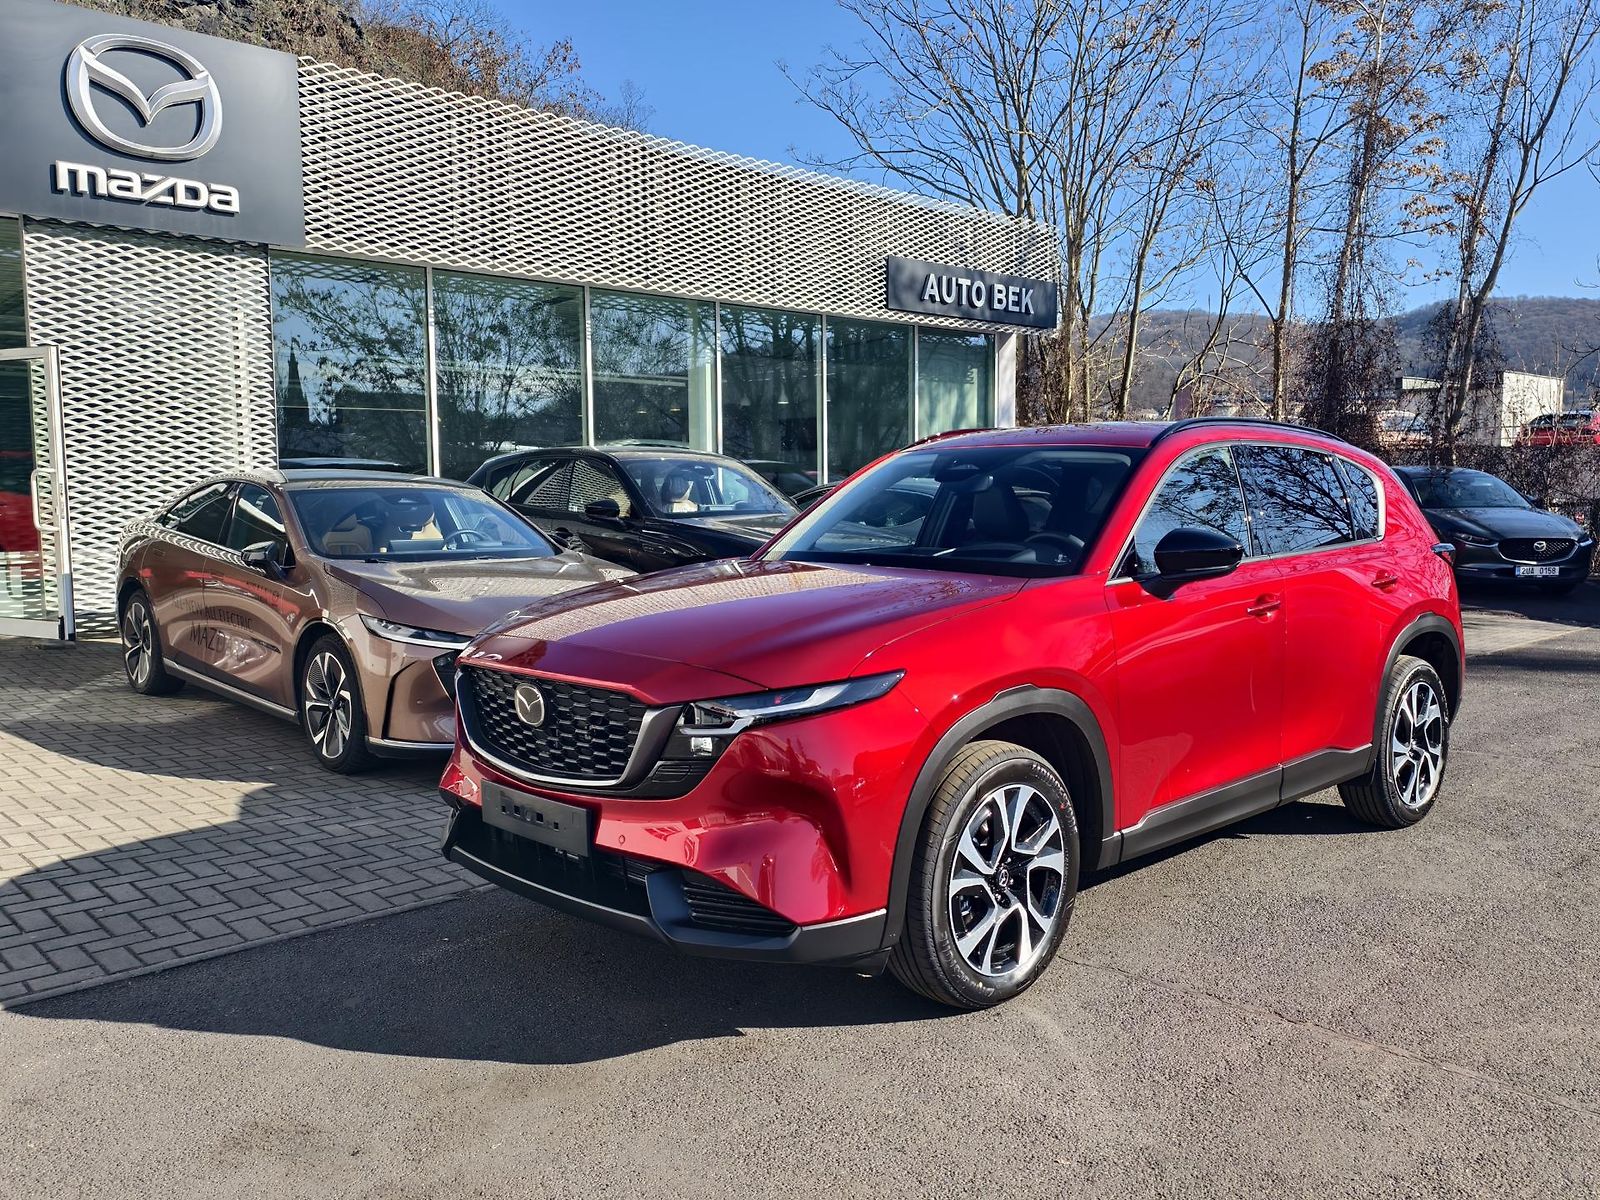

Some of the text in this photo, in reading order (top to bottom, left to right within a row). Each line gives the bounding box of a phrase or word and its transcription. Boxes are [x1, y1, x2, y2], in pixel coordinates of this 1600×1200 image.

[55, 160, 240, 215] mazda
[923, 273, 1034, 315] AUTO BEK
[1540, 567, 1557, 575] 0158
